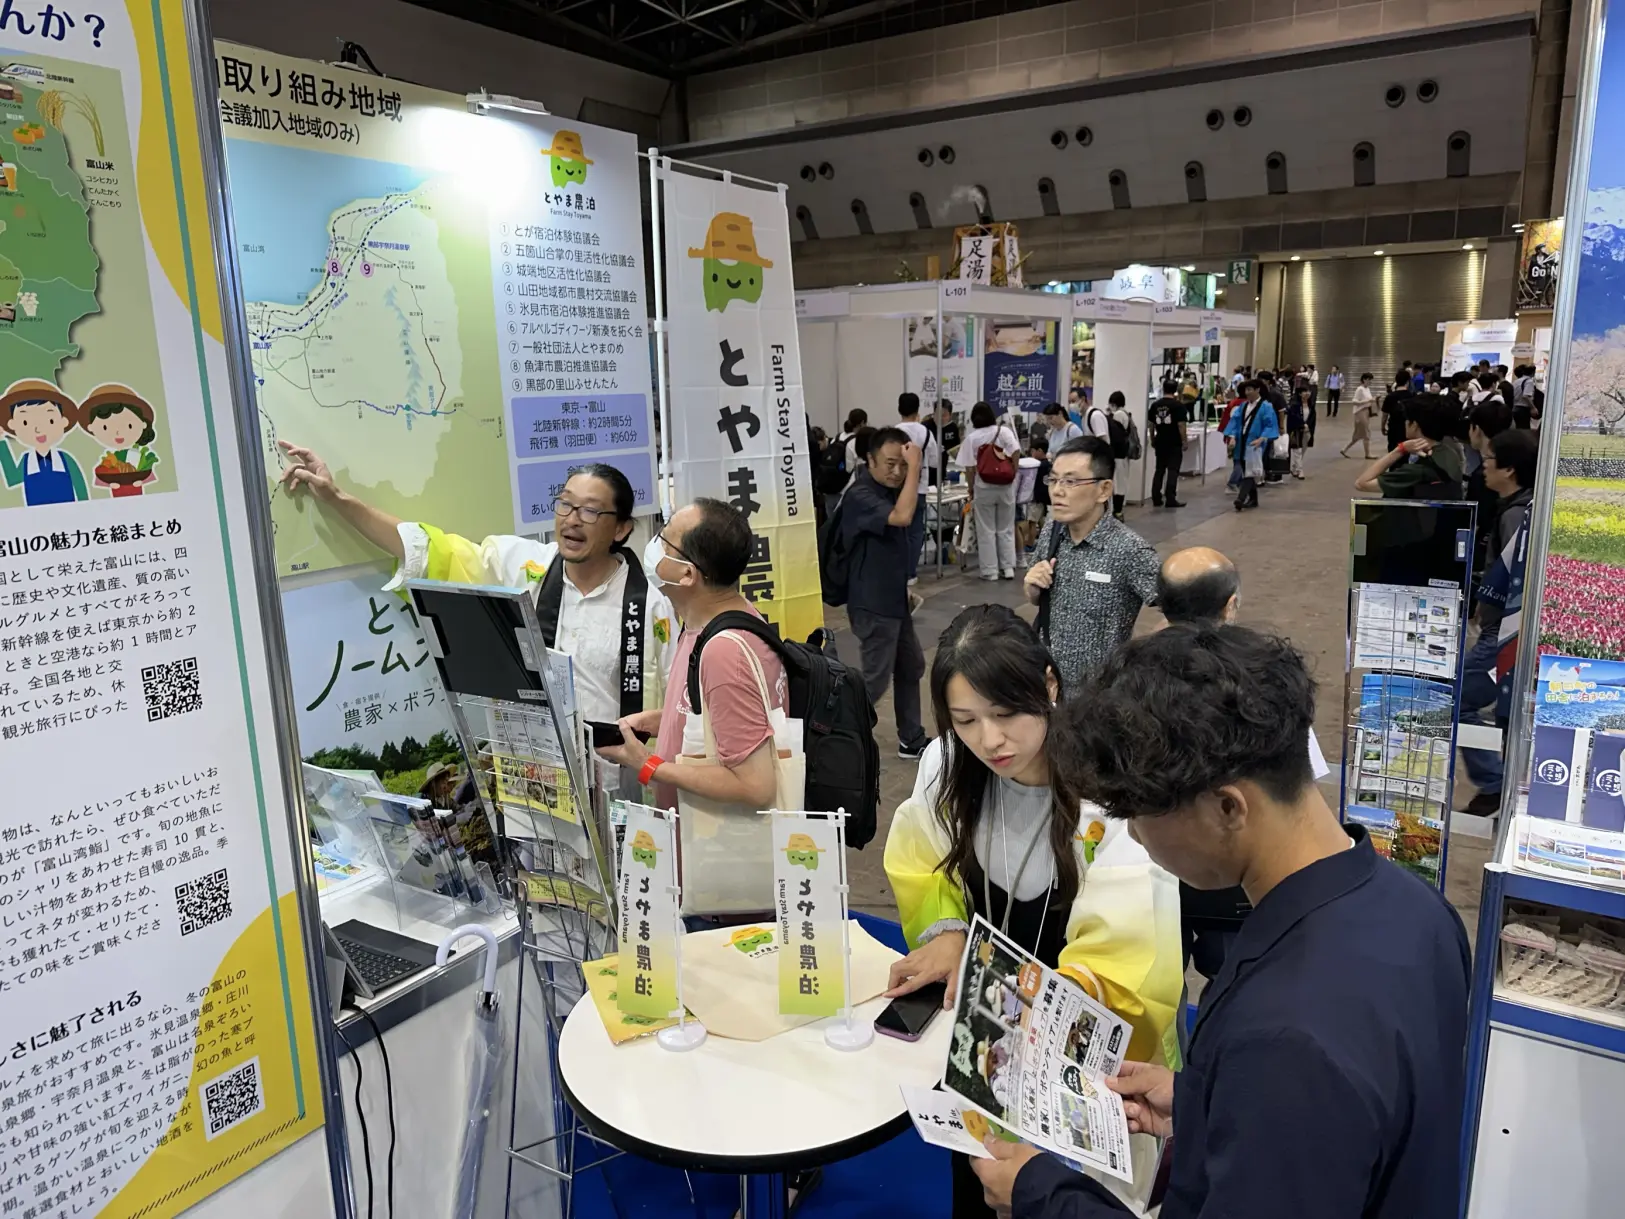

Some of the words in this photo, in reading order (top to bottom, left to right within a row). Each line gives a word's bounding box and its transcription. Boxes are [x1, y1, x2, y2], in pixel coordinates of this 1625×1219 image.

[214, 56, 403, 123] 取り組み地域
[85, 159, 115, 171] 富山米
[86, 176, 119, 185] コシヒカリ
[90, 200, 122, 208] てんこもり
[544, 191, 596, 211] とやま農泊
[550, 208, 563, 217] Farm
[564, 209, 573, 219] Stay
[574, 211, 592, 220] Toyama
[514, 225, 600, 247] とが宿泊体験協議会
[515, 244, 636, 268] 五箇山合掌の里活性化協議会
[966, 238, 987, 280] 足湯
[331, 262, 339, 274] 8
[363, 263, 371, 275] 9
[516, 265, 611, 284] 城端地区活性化協議会
[1531, 266, 1546, 278] Go
[518, 284, 637, 303] 山田地域都市農村交流協議会
[945, 287, 967, 297] L-101
[519, 302, 630, 320] 氷見市宿泊体験推進協議会
[1075, 298, 1096, 307] L-102
[522, 341, 624, 355] 一般社団法人とやまのめ
[524, 359, 617, 373] 魚津市農泊推進協議会
[771, 344, 785, 392] Farm
[525, 377, 618, 392] 黒部の里山ふせんたん
[997, 373, 1044, 392] 越前
[775, 398, 791, 439] Stay
[780, 441, 799, 518] Toyama
[623, 601, 641, 692] とやま農泊
[1, 699, 129, 741] 観光旅行にぴった
[0, 1002, 252, 1135] 泉郷・宇奈月温泉と、富山は名泉ぞろい
